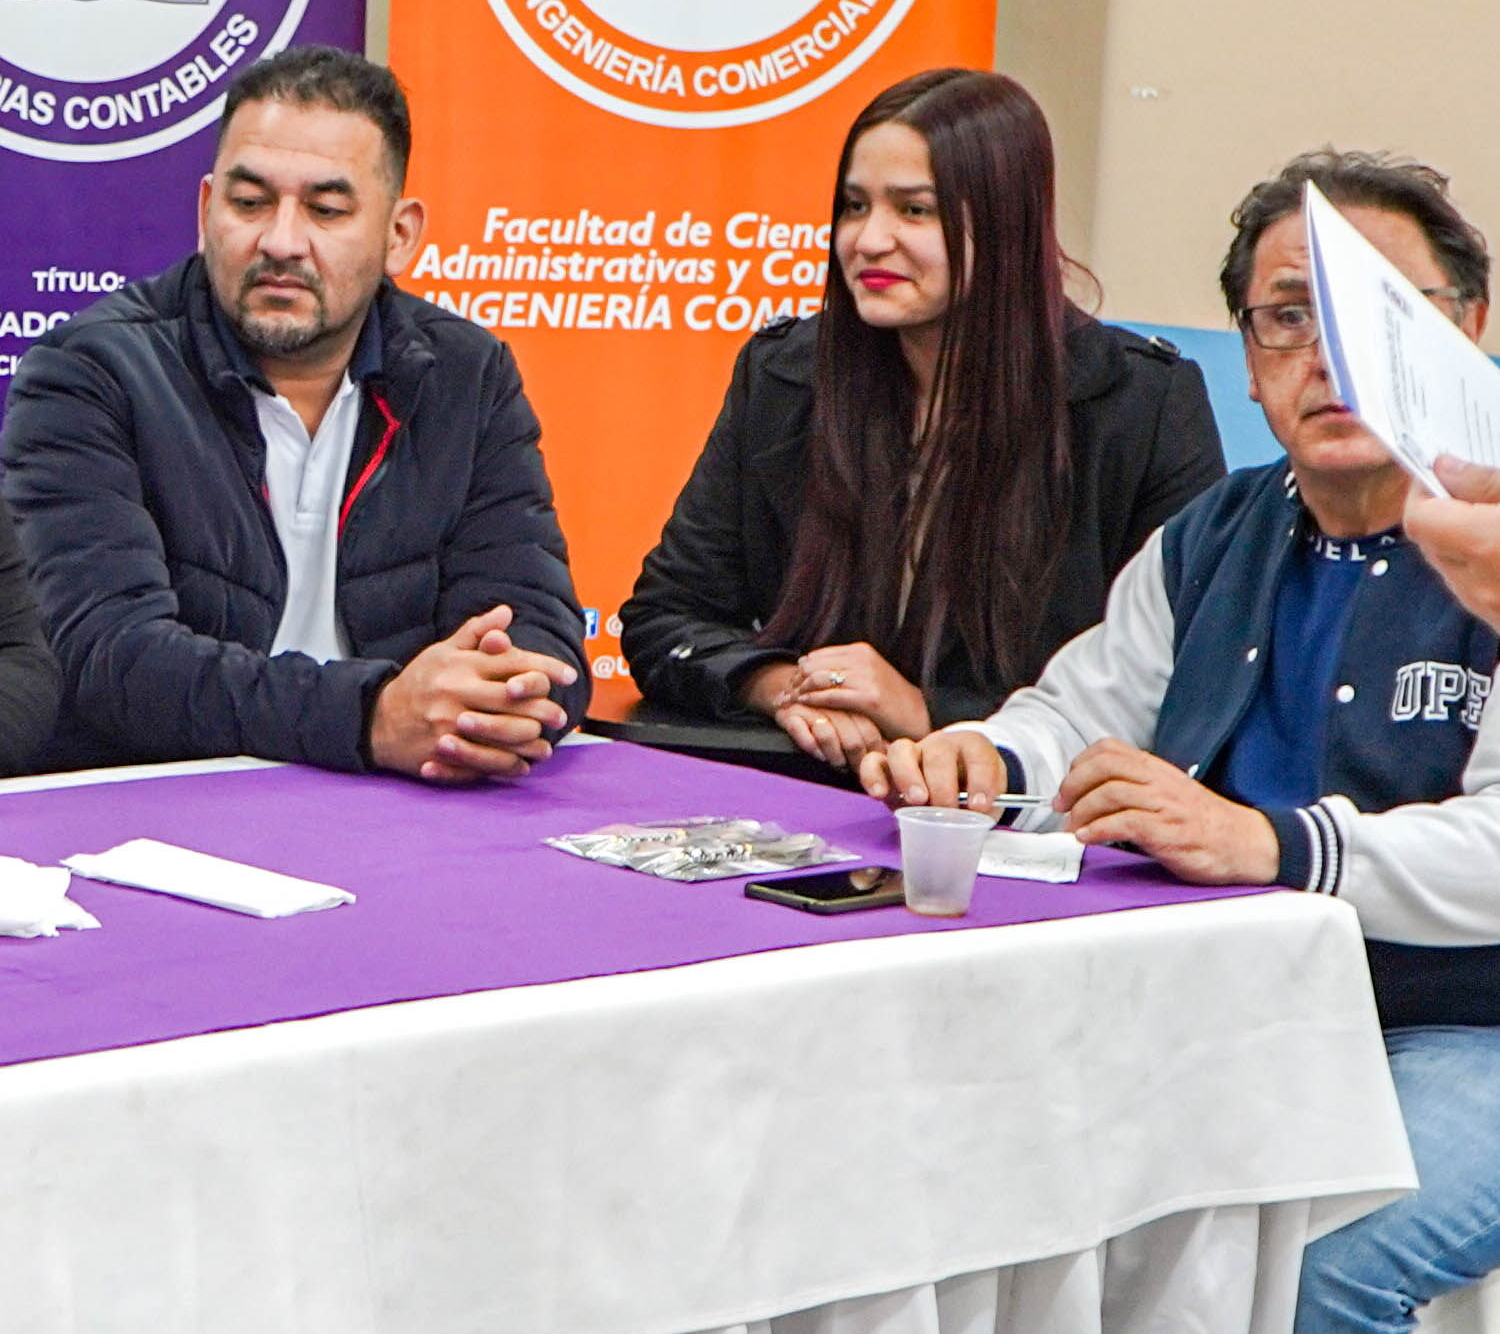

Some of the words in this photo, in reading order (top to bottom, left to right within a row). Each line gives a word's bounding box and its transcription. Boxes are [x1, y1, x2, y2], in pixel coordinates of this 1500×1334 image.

[63, 13, 259, 130] CONTABLES
[483, 208, 656, 246] Facultad
[664, 212, 712, 247] de
[724, 213, 832, 250] Cienc
[32, 266, 126, 292] TÍTULO:
[412, 244, 715, 284] Administrativas
[726, 258, 751, 295] y
[684, 295, 822, 332] COME
[1391, 661, 1492, 730] UPE
